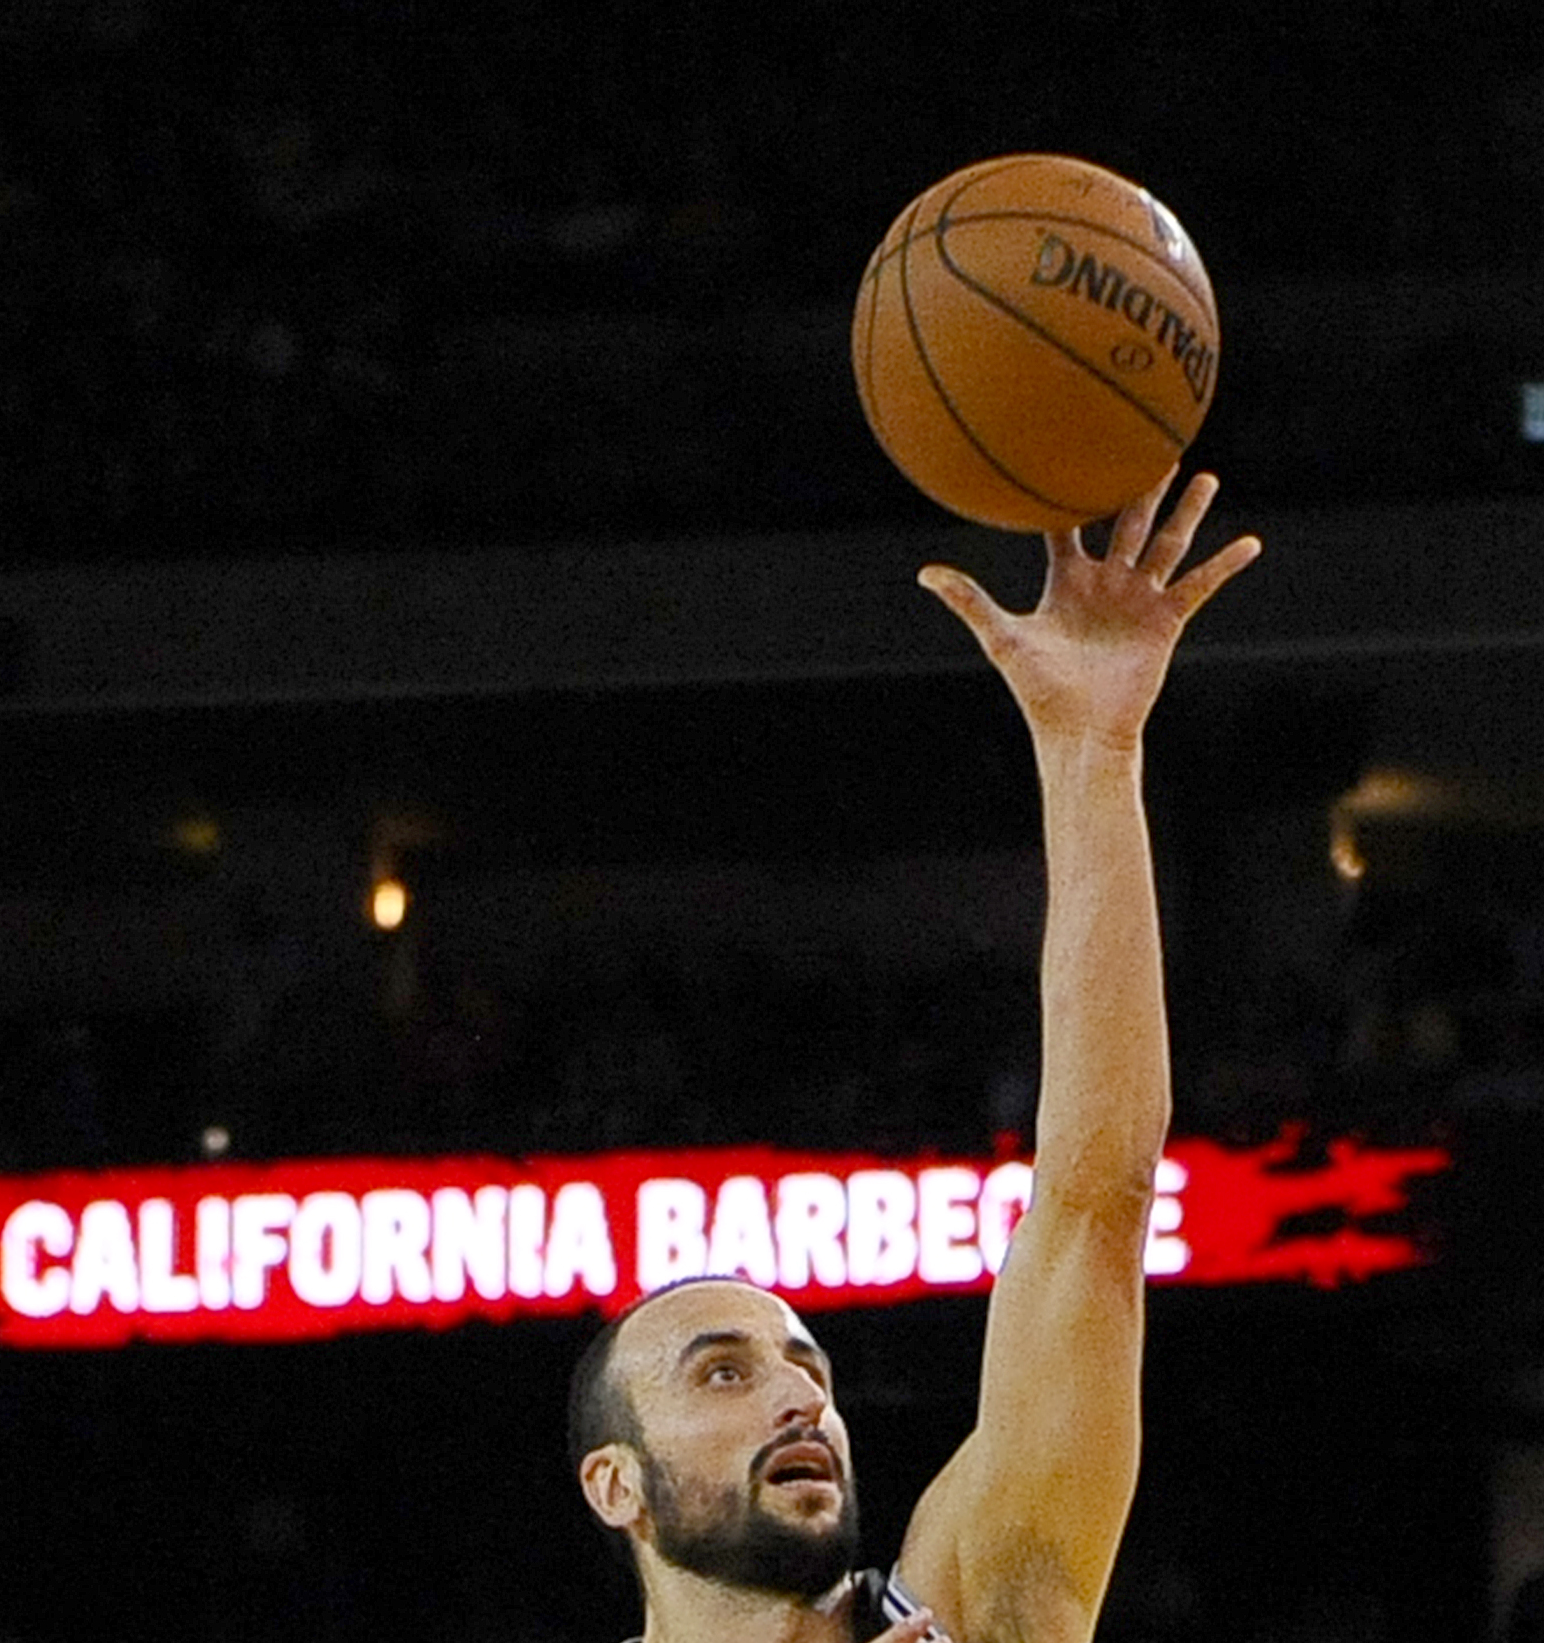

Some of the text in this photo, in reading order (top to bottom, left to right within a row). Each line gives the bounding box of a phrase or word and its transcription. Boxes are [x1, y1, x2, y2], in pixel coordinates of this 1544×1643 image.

[1030, 233, 1215, 403] PALDING
[0, 1158, 1192, 1317] CALIFORNIA BARBECE
